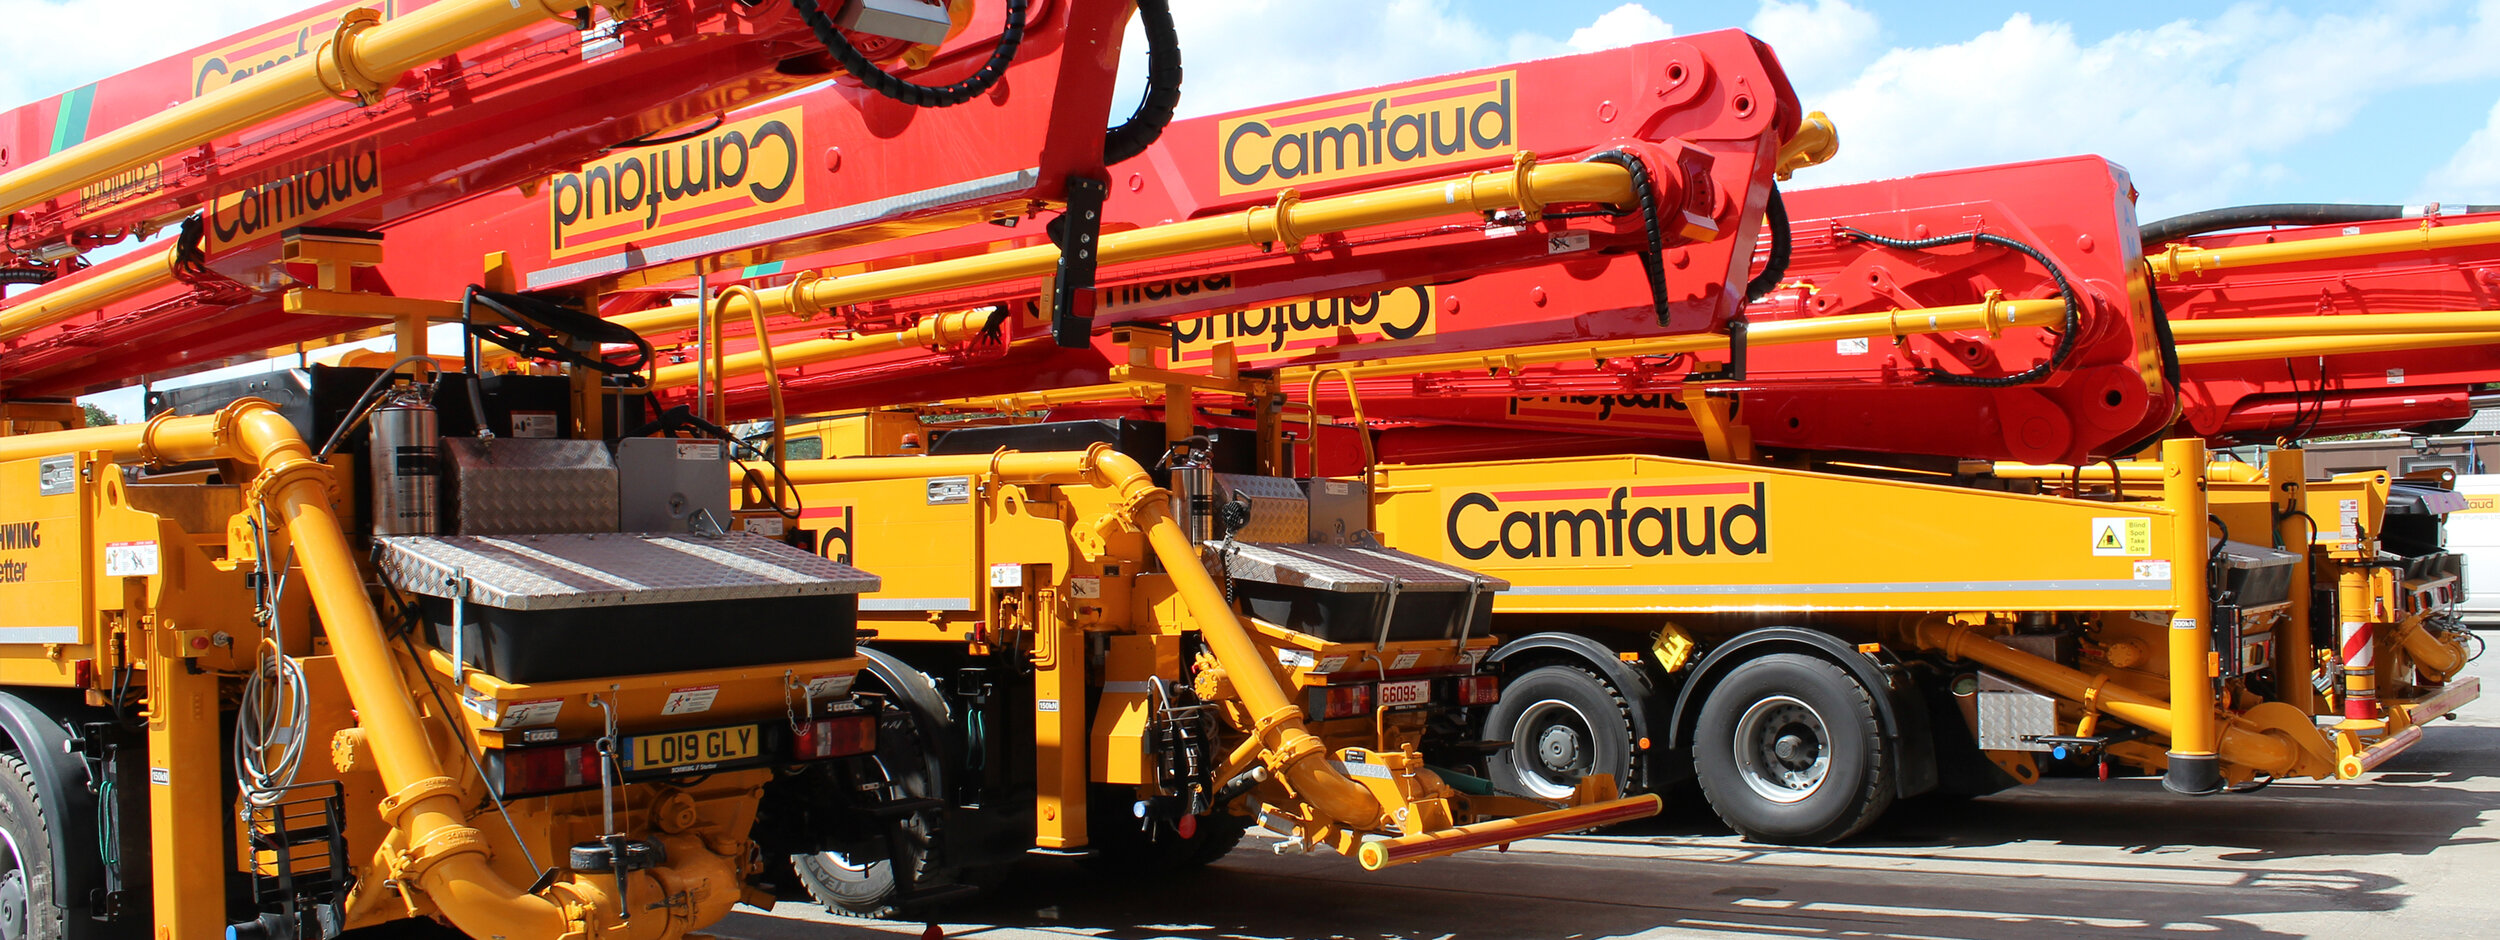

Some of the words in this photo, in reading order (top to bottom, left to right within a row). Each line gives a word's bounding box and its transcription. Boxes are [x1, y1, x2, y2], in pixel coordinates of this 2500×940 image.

[1224, 78, 1511, 185] Camfaud
[554, 120, 798, 250] Camfaud
[1446, 481, 1767, 561] Camfaud
[1382, 684, 1416, 703] 66095
[707, 728, 751, 758] GLY
